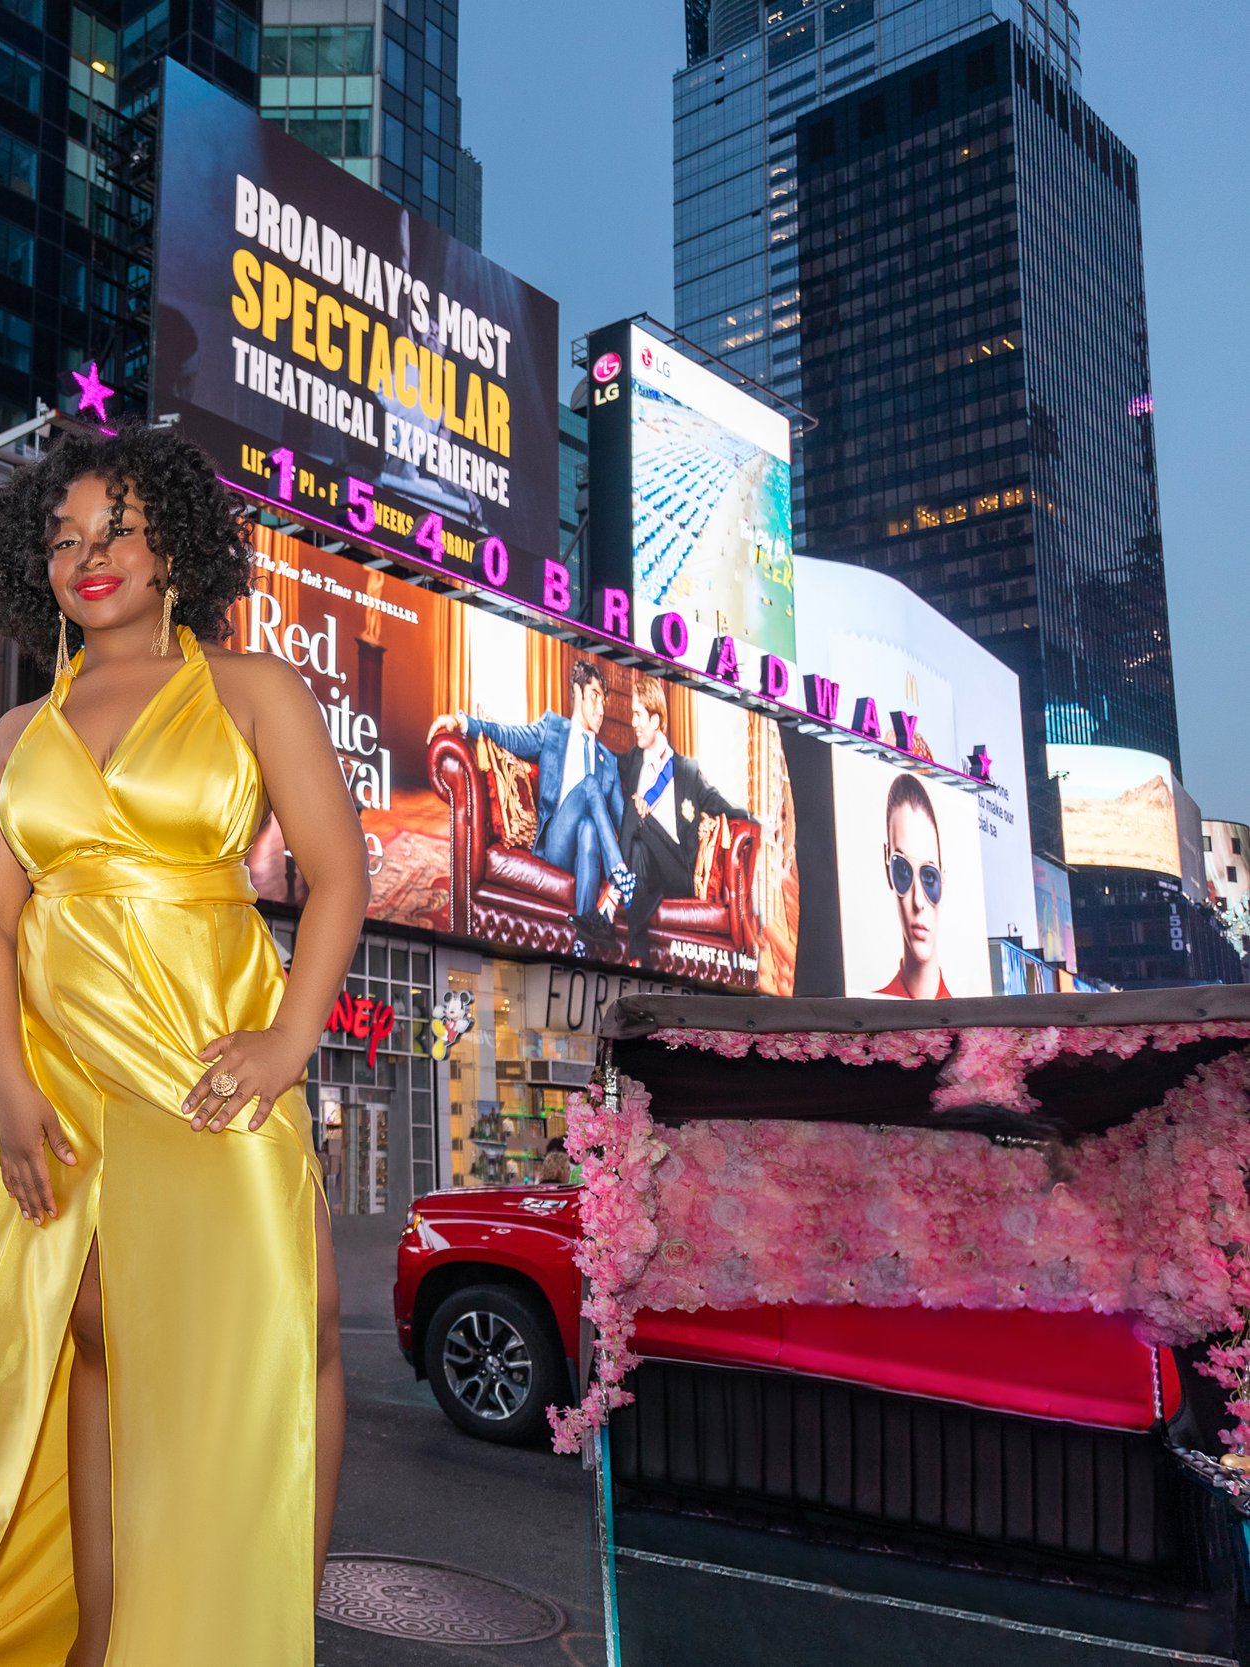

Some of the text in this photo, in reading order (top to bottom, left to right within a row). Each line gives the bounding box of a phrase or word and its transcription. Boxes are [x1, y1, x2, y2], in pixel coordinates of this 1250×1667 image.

[235, 173, 510, 379] BROADWAY'S MOST
[232, 248, 511, 458] SPECTACULAR
[594, 382, 620, 406] LG
[655, 356, 671, 378] LG
[232, 336, 510, 508] THEATRICAL EXPERIENCE
[255, 551, 419, 625] The New York Times BESTSELLER
[245, 588, 348, 684] Red,
[544, 557, 919, 751] BROADWAY
[670, 939, 717, 964] AUGUST
[717, 949, 730, 966] 11
[1170, 903, 1183, 951] 1500
